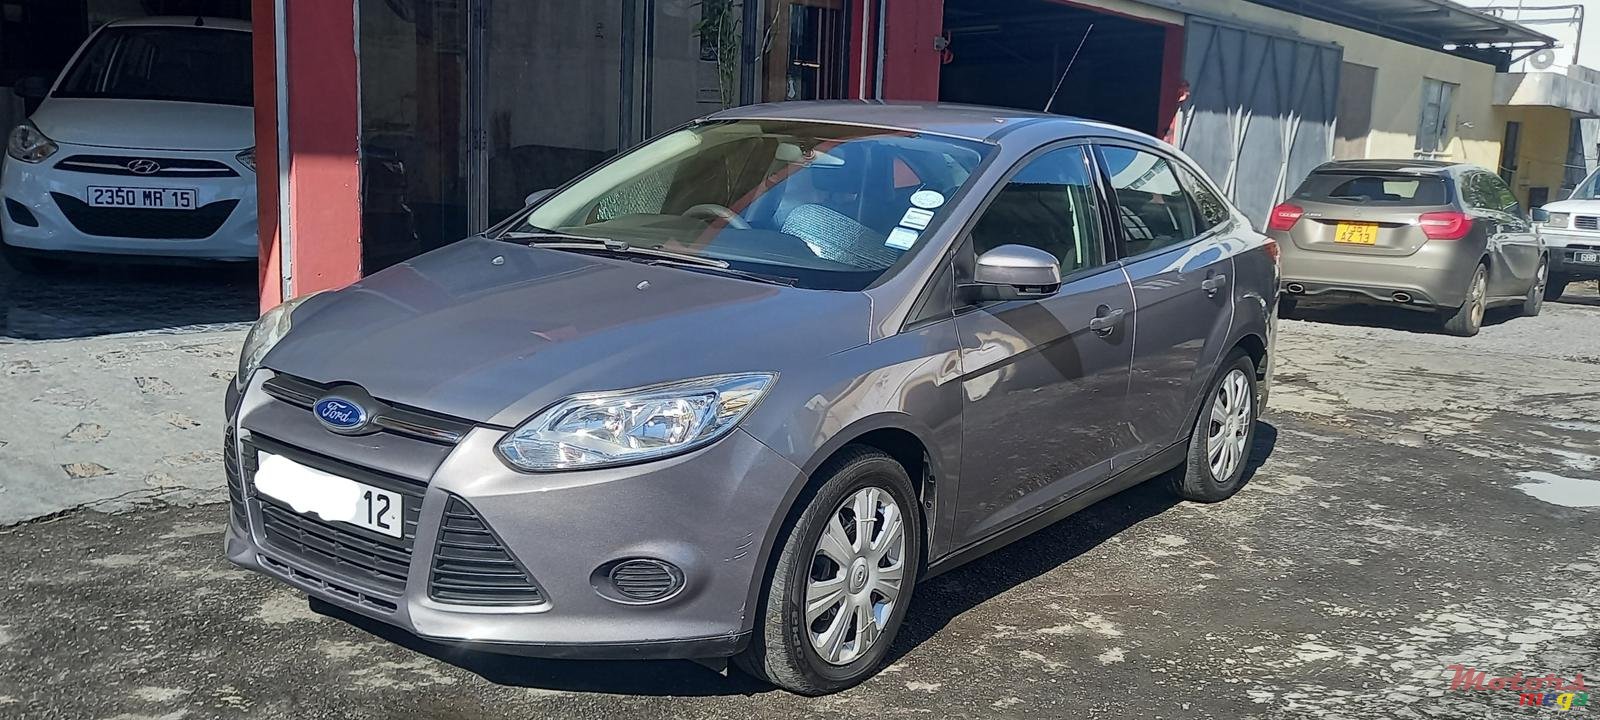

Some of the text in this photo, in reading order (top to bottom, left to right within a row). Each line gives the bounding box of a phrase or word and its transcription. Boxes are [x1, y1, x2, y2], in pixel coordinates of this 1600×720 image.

[94, 189, 190, 208] 2350 MR 15
[1341, 232, 1370, 242] AZ 13
[321, 401, 352, 423] Ford
[363, 490, 390, 530] 12
